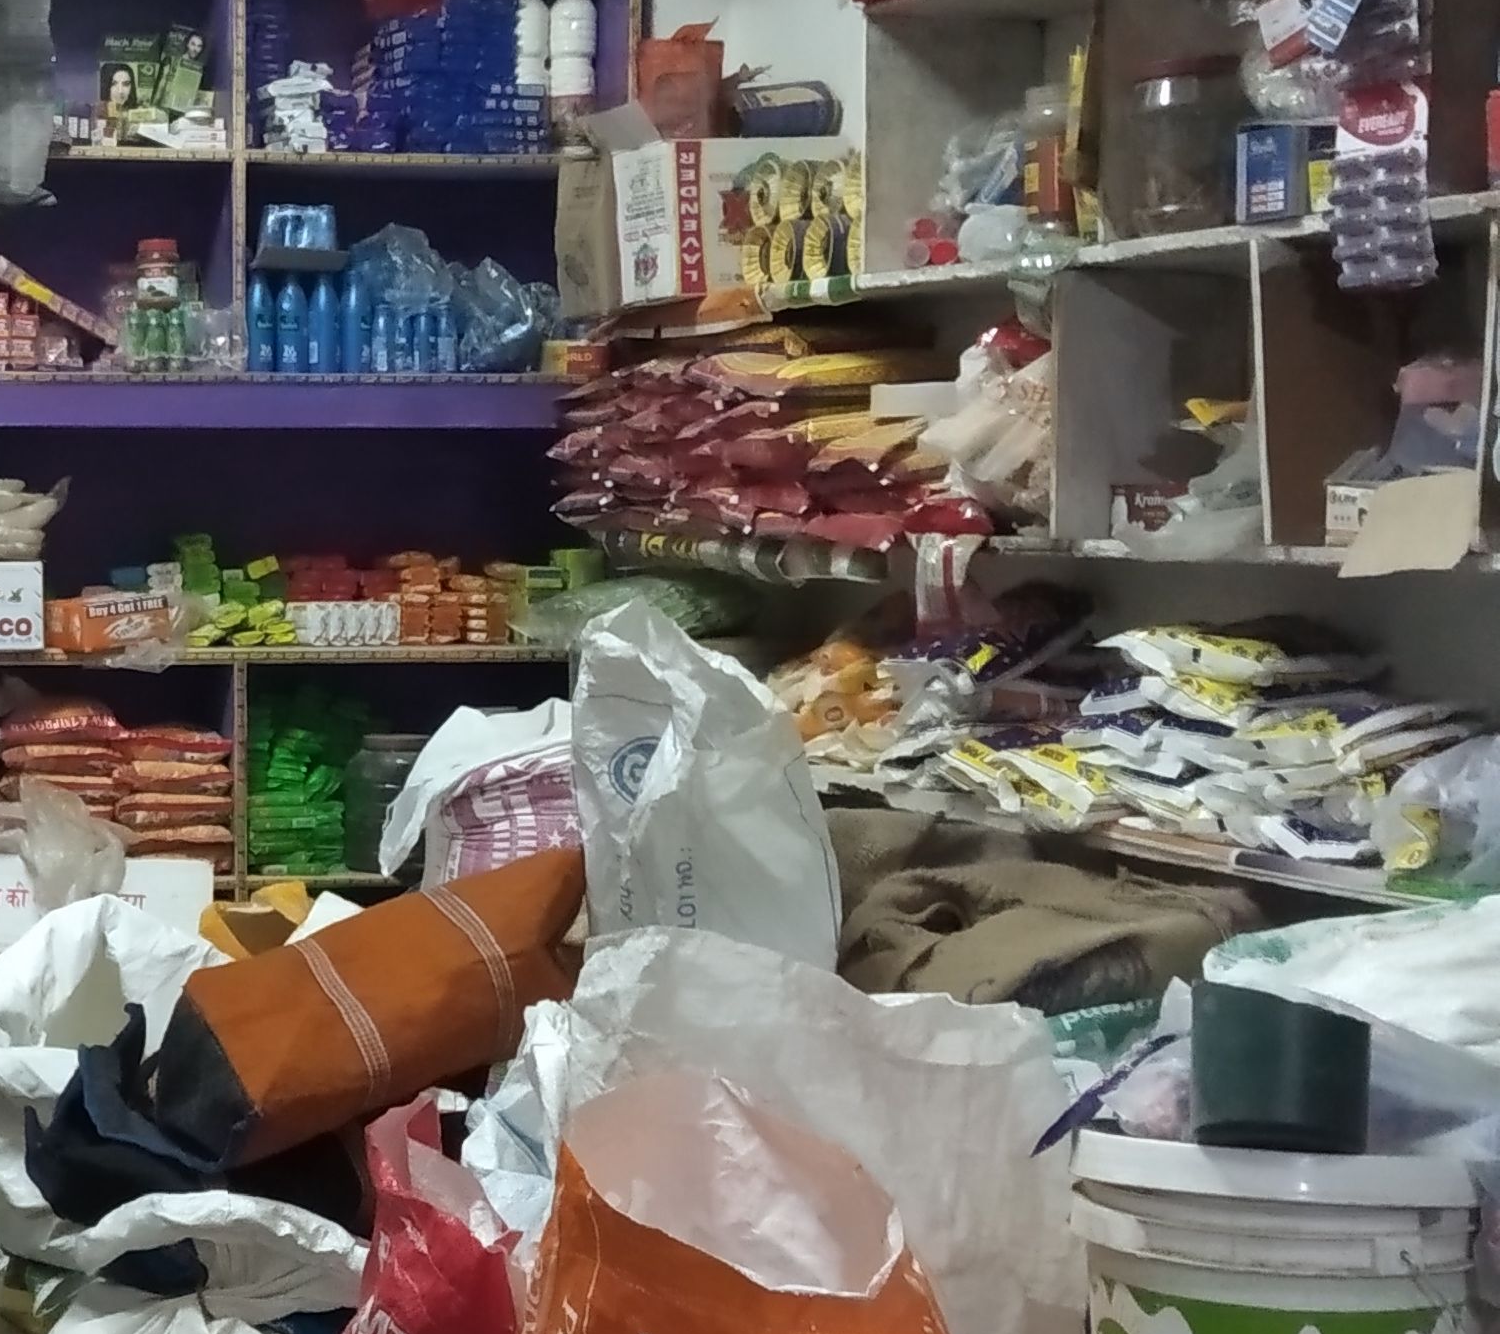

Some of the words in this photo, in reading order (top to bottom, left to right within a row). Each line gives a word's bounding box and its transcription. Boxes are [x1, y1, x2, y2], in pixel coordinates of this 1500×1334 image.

[88, 606, 108, 618] Buy
[118, 602, 134, 614] Get
[143, 598, 164, 610] FREE
[6, 881, 28, 907] की
